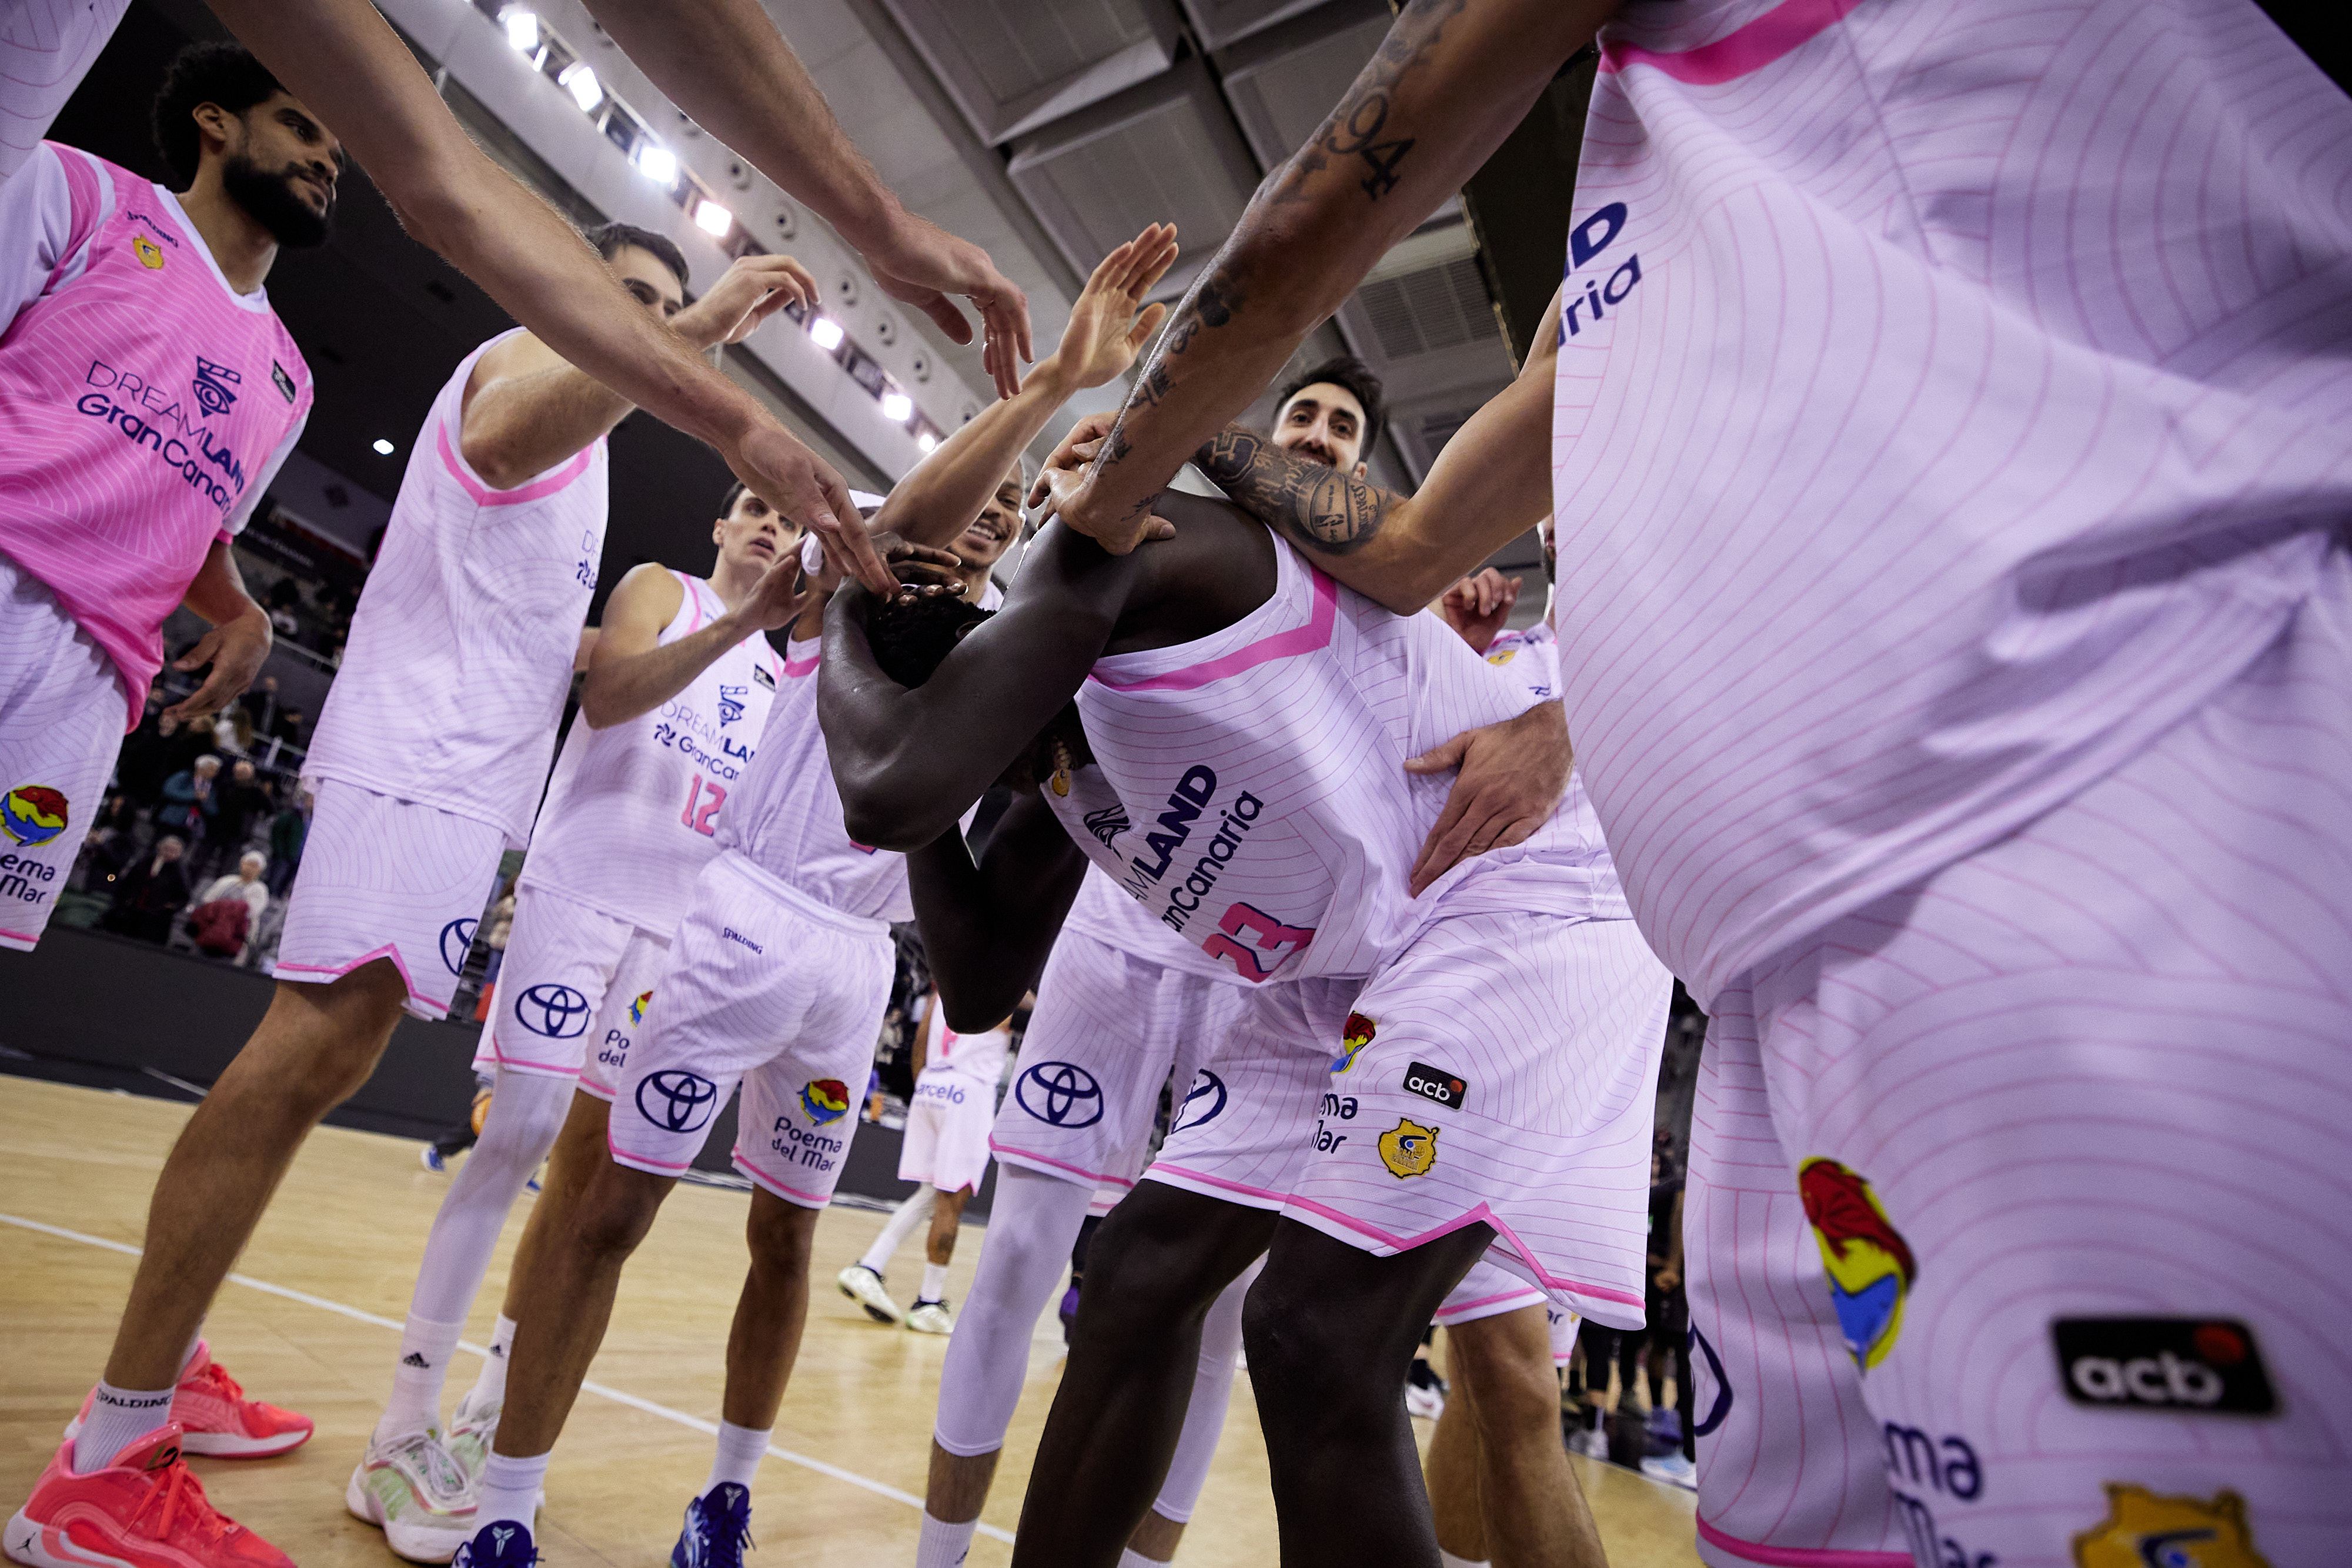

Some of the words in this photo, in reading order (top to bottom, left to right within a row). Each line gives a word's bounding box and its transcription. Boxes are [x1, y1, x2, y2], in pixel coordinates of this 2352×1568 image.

[681, 773, 727, 837] 12
[0, 874, 46, 904] Mar
[722, 927, 763, 955] SPALDING
[599, 1049, 626, 1068] del
[1409, 1076, 1450, 1101] acb
[774, 1116, 843, 1153] Poema
[771, 1138, 797, 1162] del
[801, 1149, 836, 1171] Mar
[2071, 1350, 2225, 1404] acb
